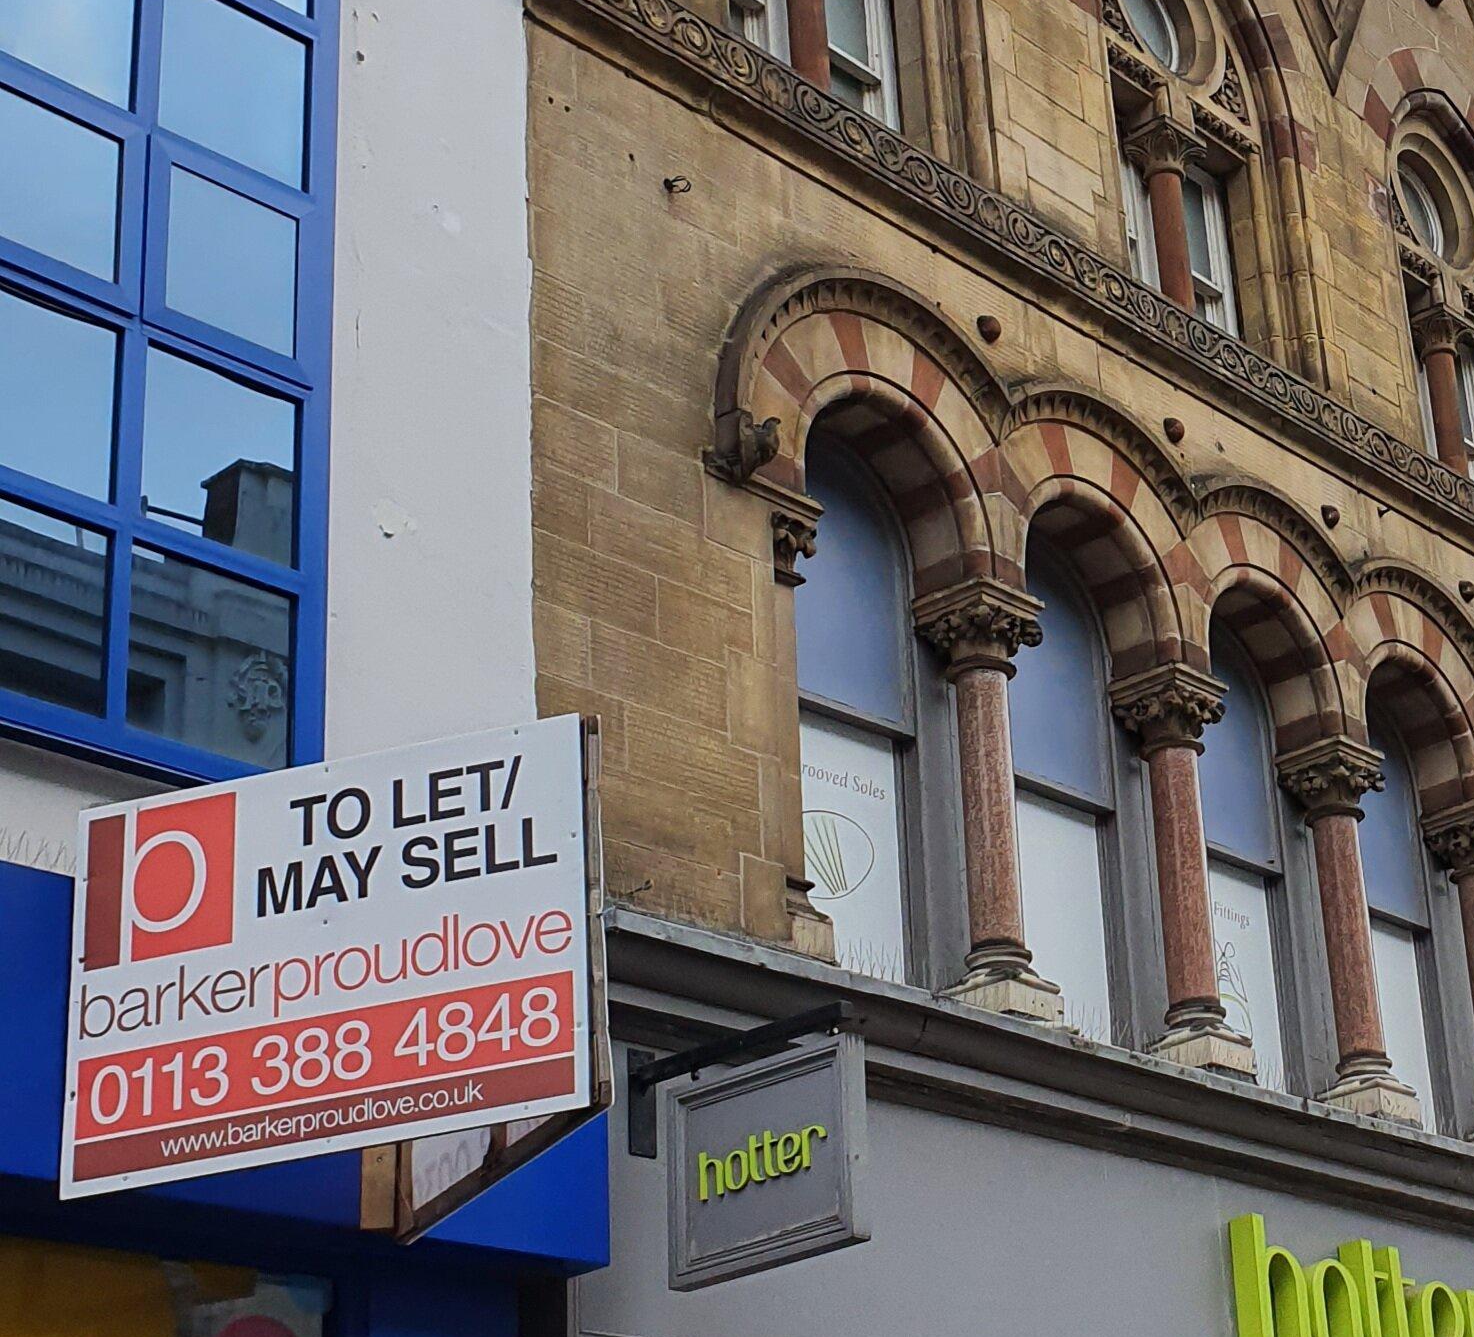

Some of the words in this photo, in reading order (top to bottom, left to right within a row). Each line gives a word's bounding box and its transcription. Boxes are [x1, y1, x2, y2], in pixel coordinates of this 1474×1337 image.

[290, 787, 371, 847] TO
[392, 754, 523, 829] LET/
[852, 775, 886, 800] Soles
[257, 845, 384, 919] MAY
[401, 817, 559, 890] SELL
[78, 909, 574, 1041] barkerproudlove
[89, 1045, 230, 1125] 0113
[250, 1019, 373, 1096] 388
[393, 986, 561, 1067] 4848
[160, 1079, 485, 1157] www.barkerproudlove.co.uk
[697, 1122, 829, 1202] hotter
